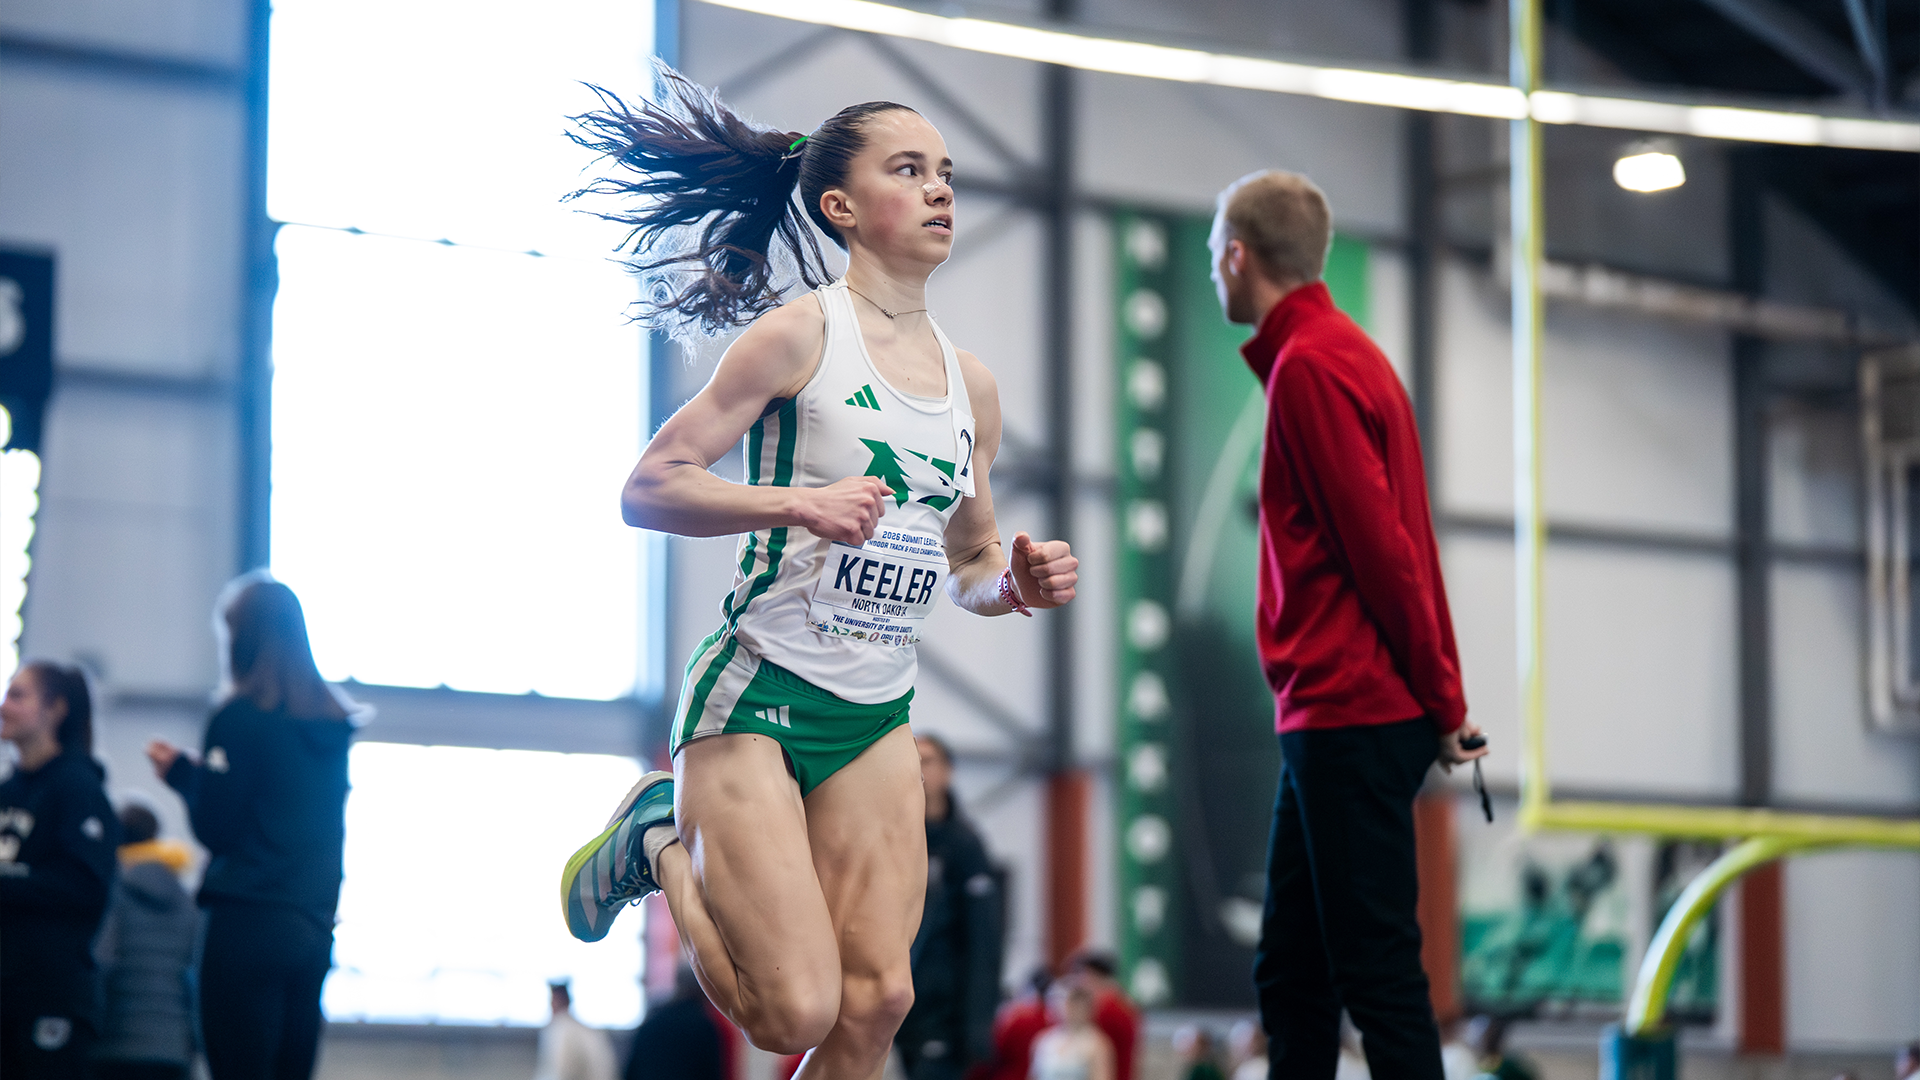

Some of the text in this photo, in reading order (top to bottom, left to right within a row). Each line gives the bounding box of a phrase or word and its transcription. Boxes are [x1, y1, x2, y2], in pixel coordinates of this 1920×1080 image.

[882, 531, 901, 541] 2026
[901, 534, 923, 545] SUMMIT
[890, 543, 904, 552] TRACK
[908, 546, 919, 554] FIELD
[834, 554, 937, 604] KEELER
[852, 598, 880, 613] NORTH
[833, 614, 845, 623] THE
[845, 617, 878, 630] UNIVERSITY
[877, 622, 885, 631] OF
[884, 624, 900, 632] NORTH
